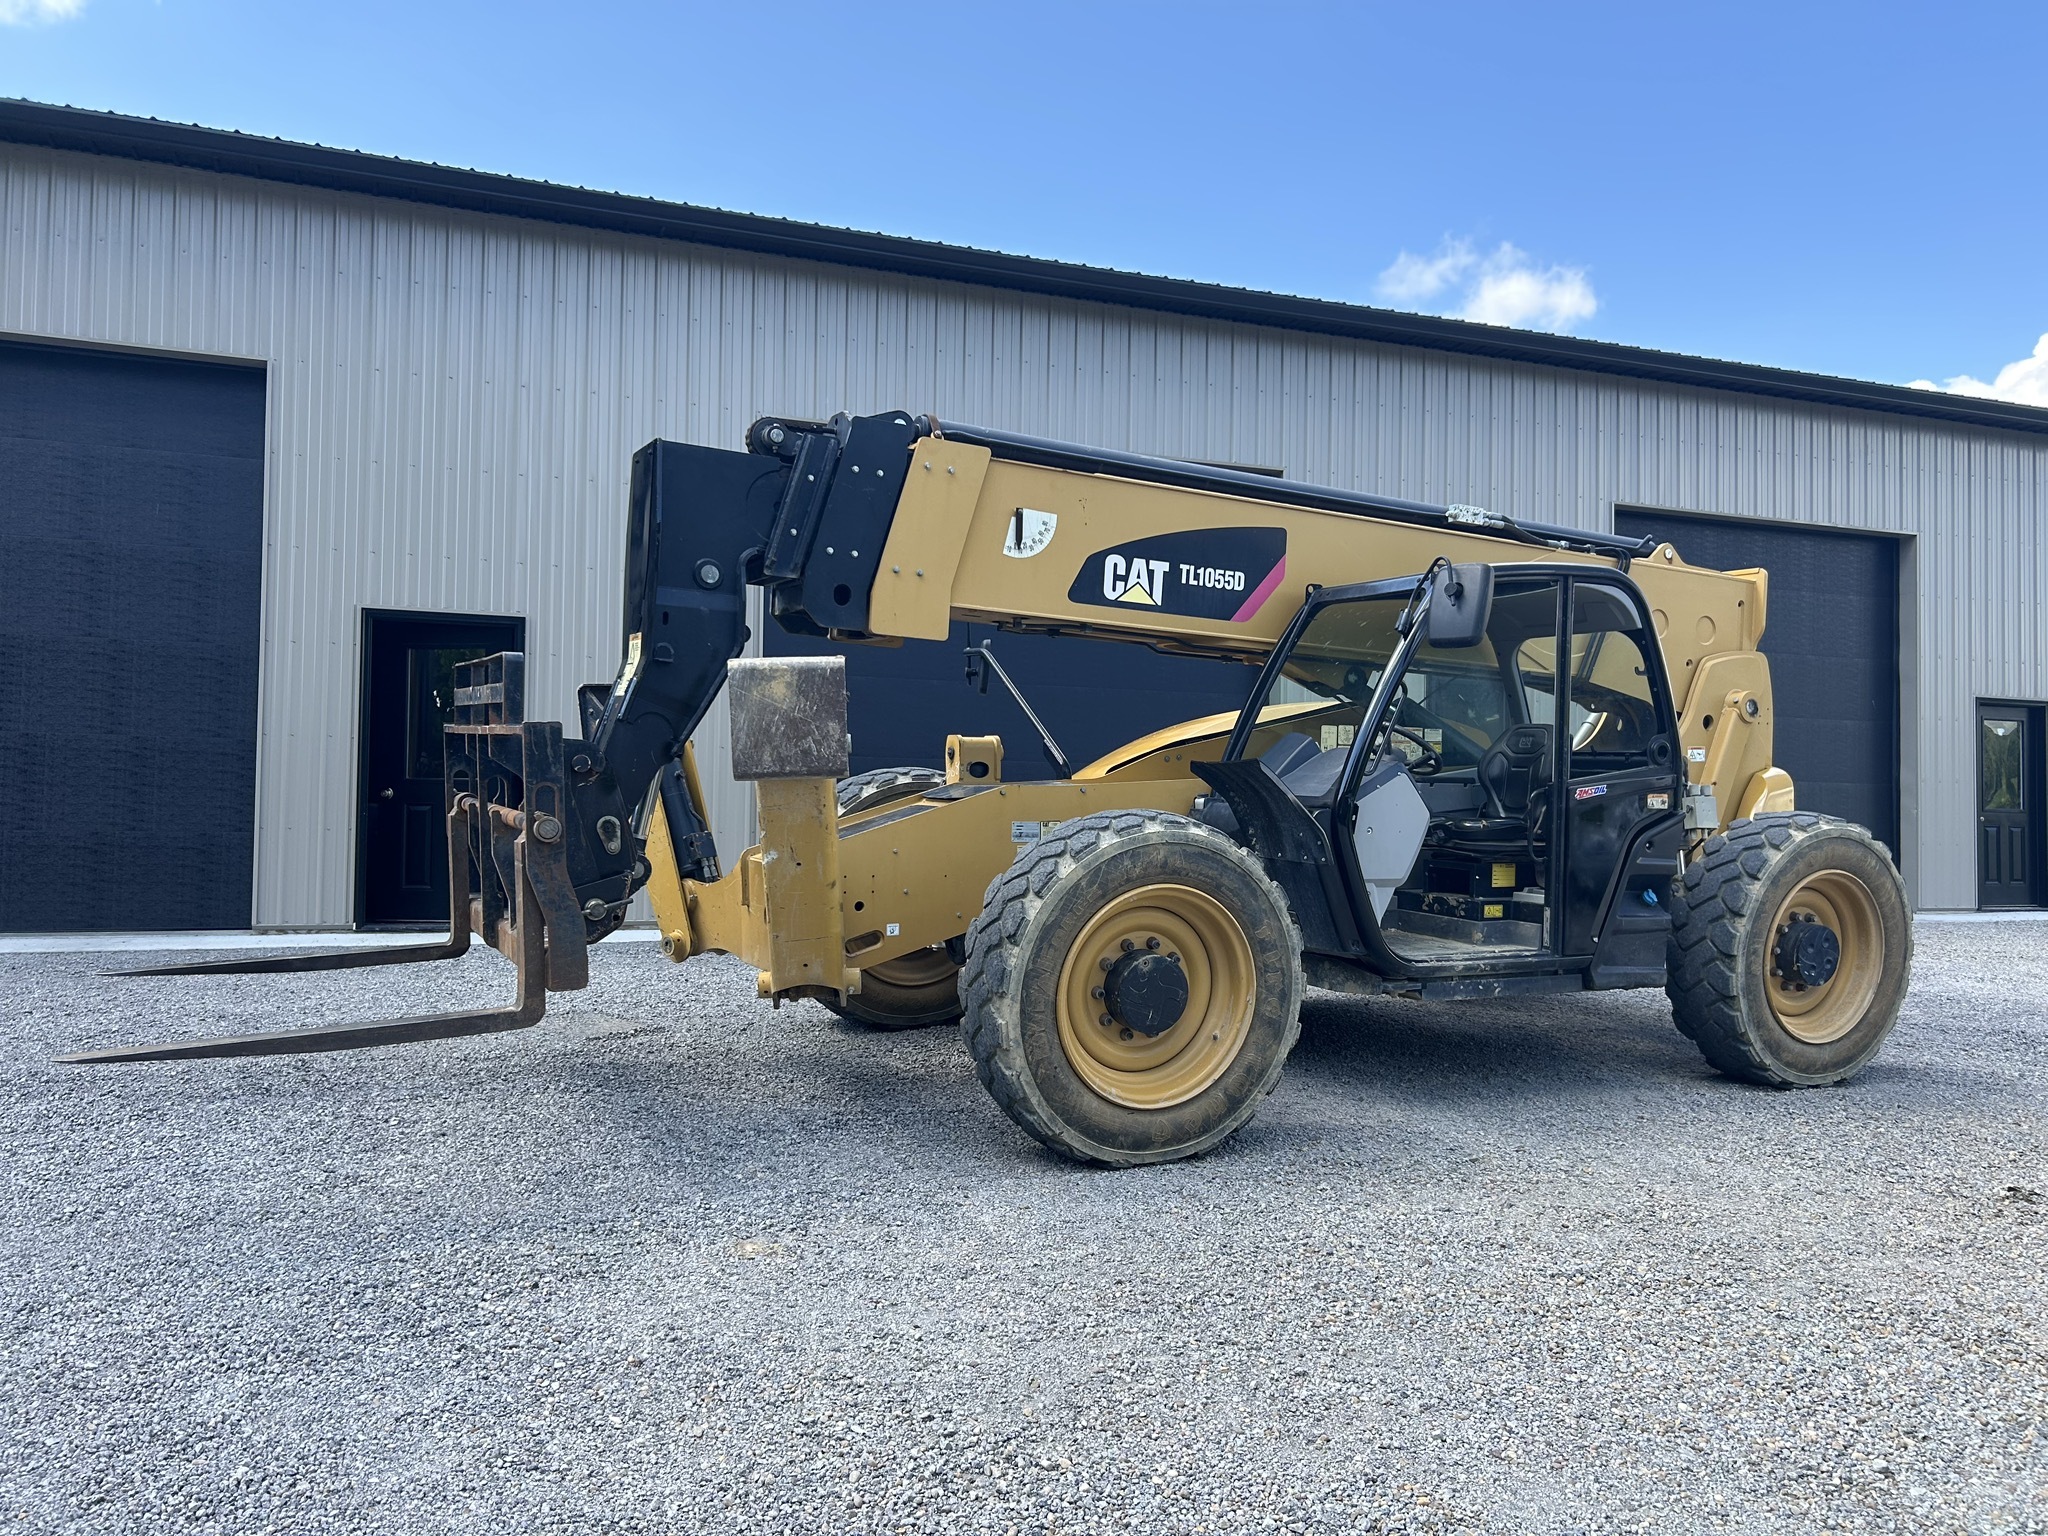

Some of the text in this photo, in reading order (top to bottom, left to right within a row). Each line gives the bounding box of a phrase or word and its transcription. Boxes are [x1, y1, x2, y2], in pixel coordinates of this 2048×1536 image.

[1103, 554, 1246, 606] CAT TL1055D
[1576, 786, 1606, 799] AMSOIL
